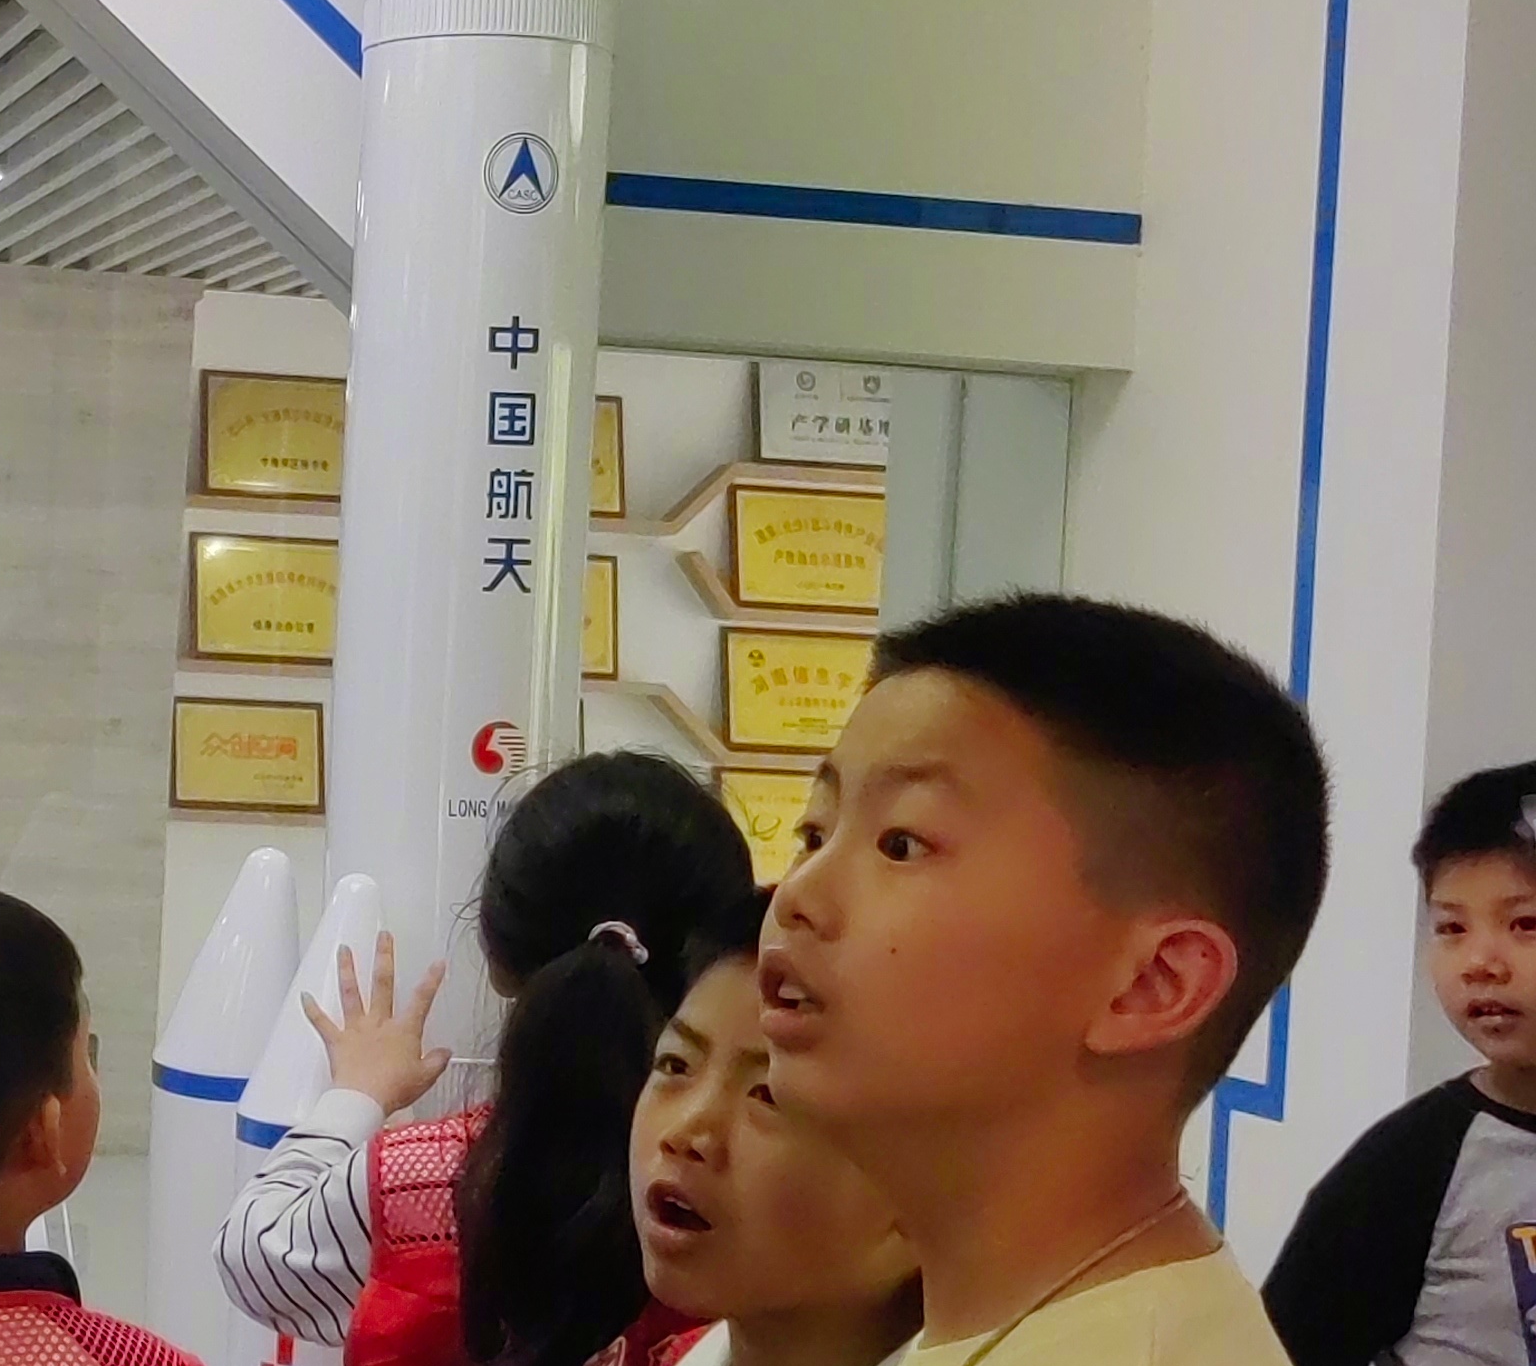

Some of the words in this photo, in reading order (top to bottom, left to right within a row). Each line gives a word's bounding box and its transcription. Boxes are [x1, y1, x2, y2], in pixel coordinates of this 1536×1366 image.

[507, 189, 539, 202] CASC
[482, 315, 539, 593] 中国航天
[448, 798, 487, 818] LONG
